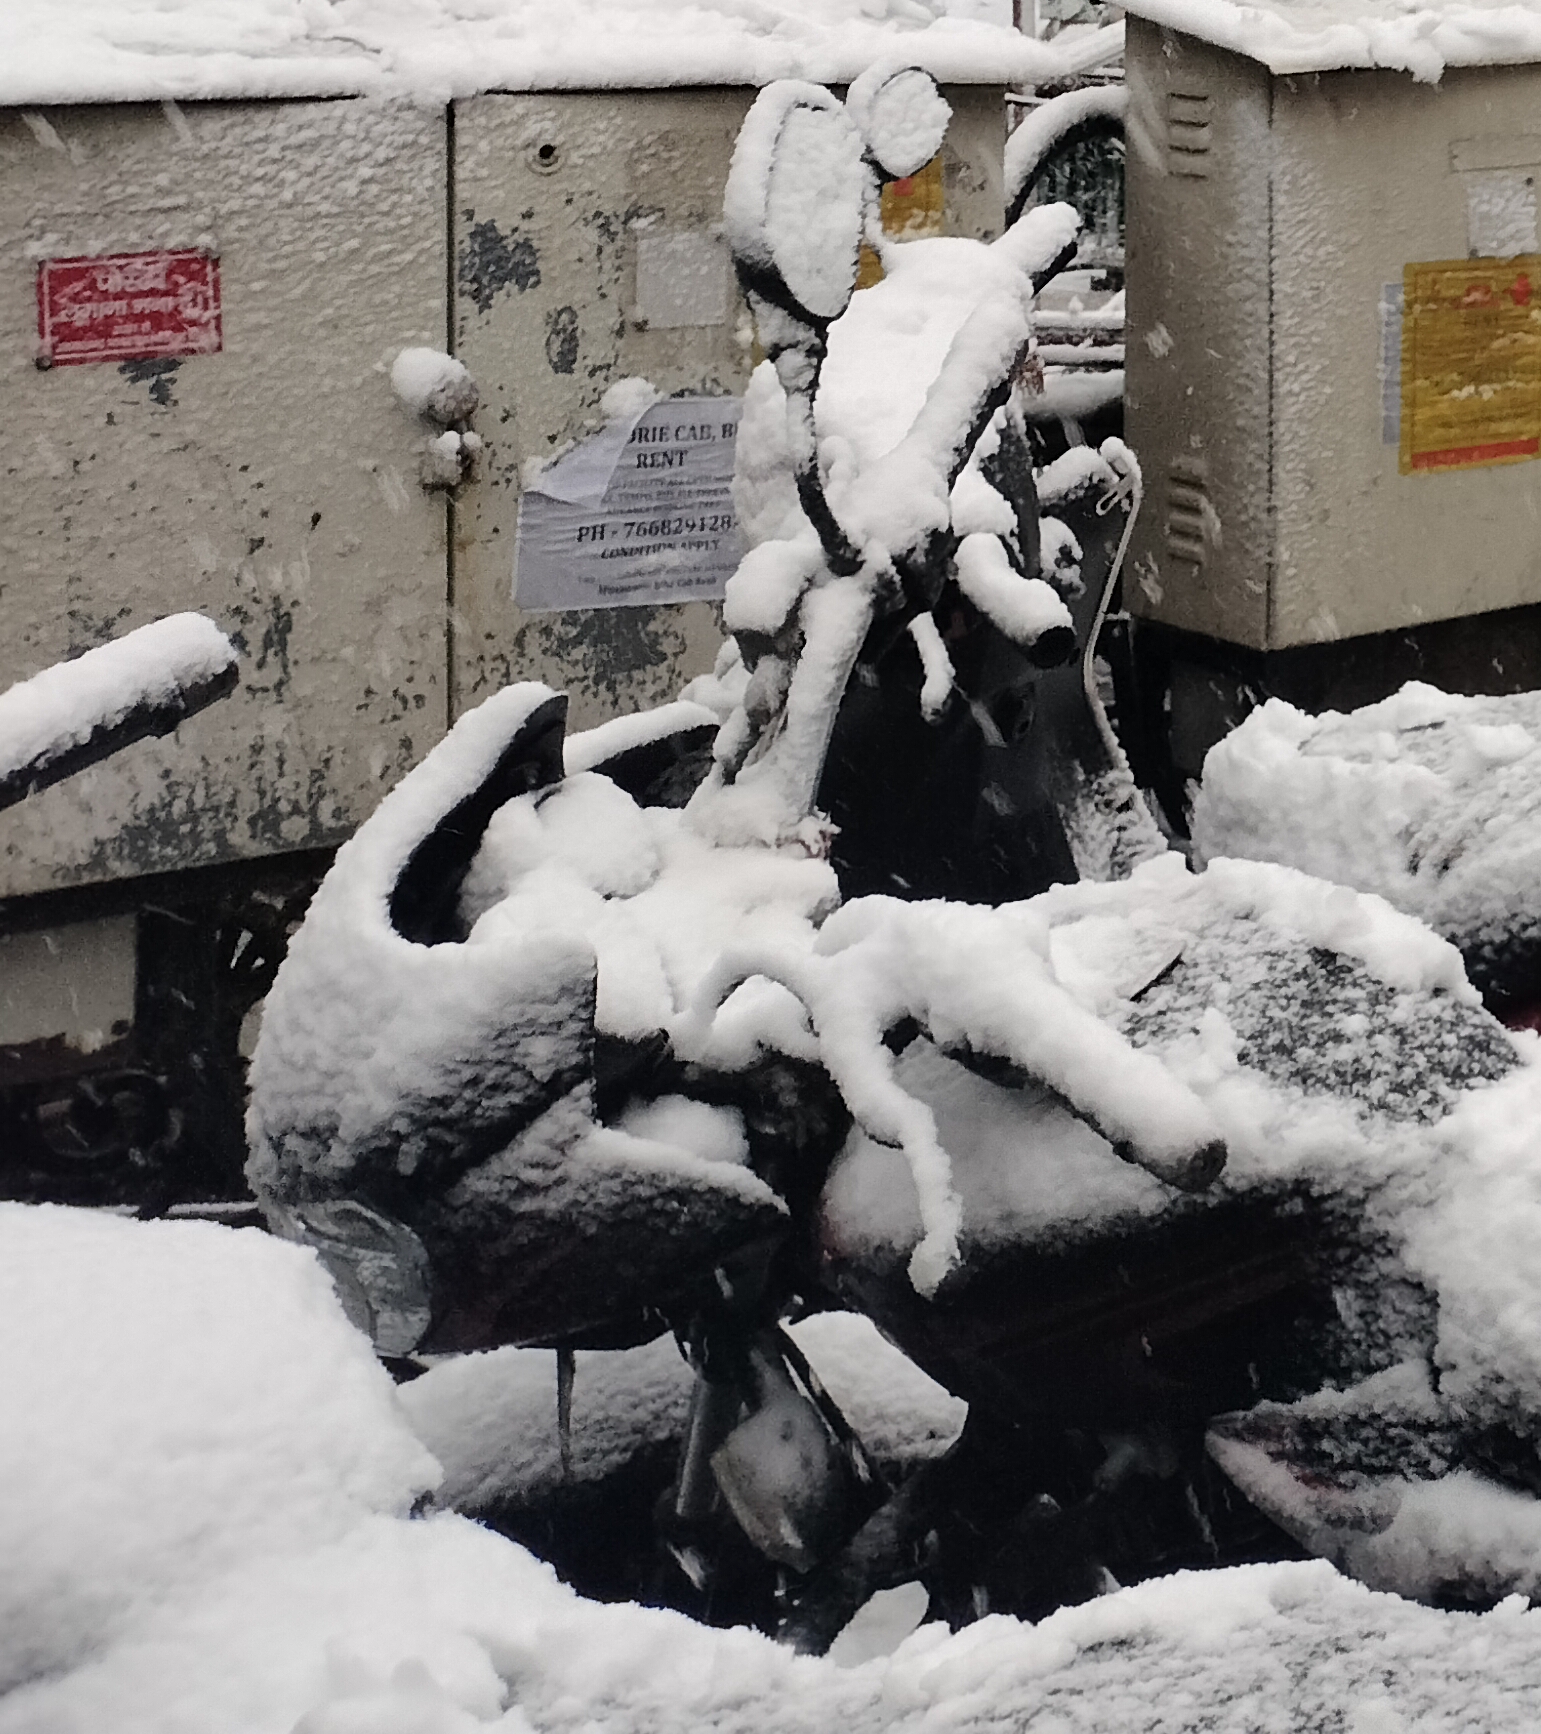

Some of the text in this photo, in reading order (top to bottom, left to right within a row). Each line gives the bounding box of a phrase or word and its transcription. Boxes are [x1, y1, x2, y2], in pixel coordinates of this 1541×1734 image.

[673, 422, 717, 443] CAB,
[635, 449, 689, 470] RENT
[576, 523, 607, 543] PH
[622, 514, 739, 539] 766829128
